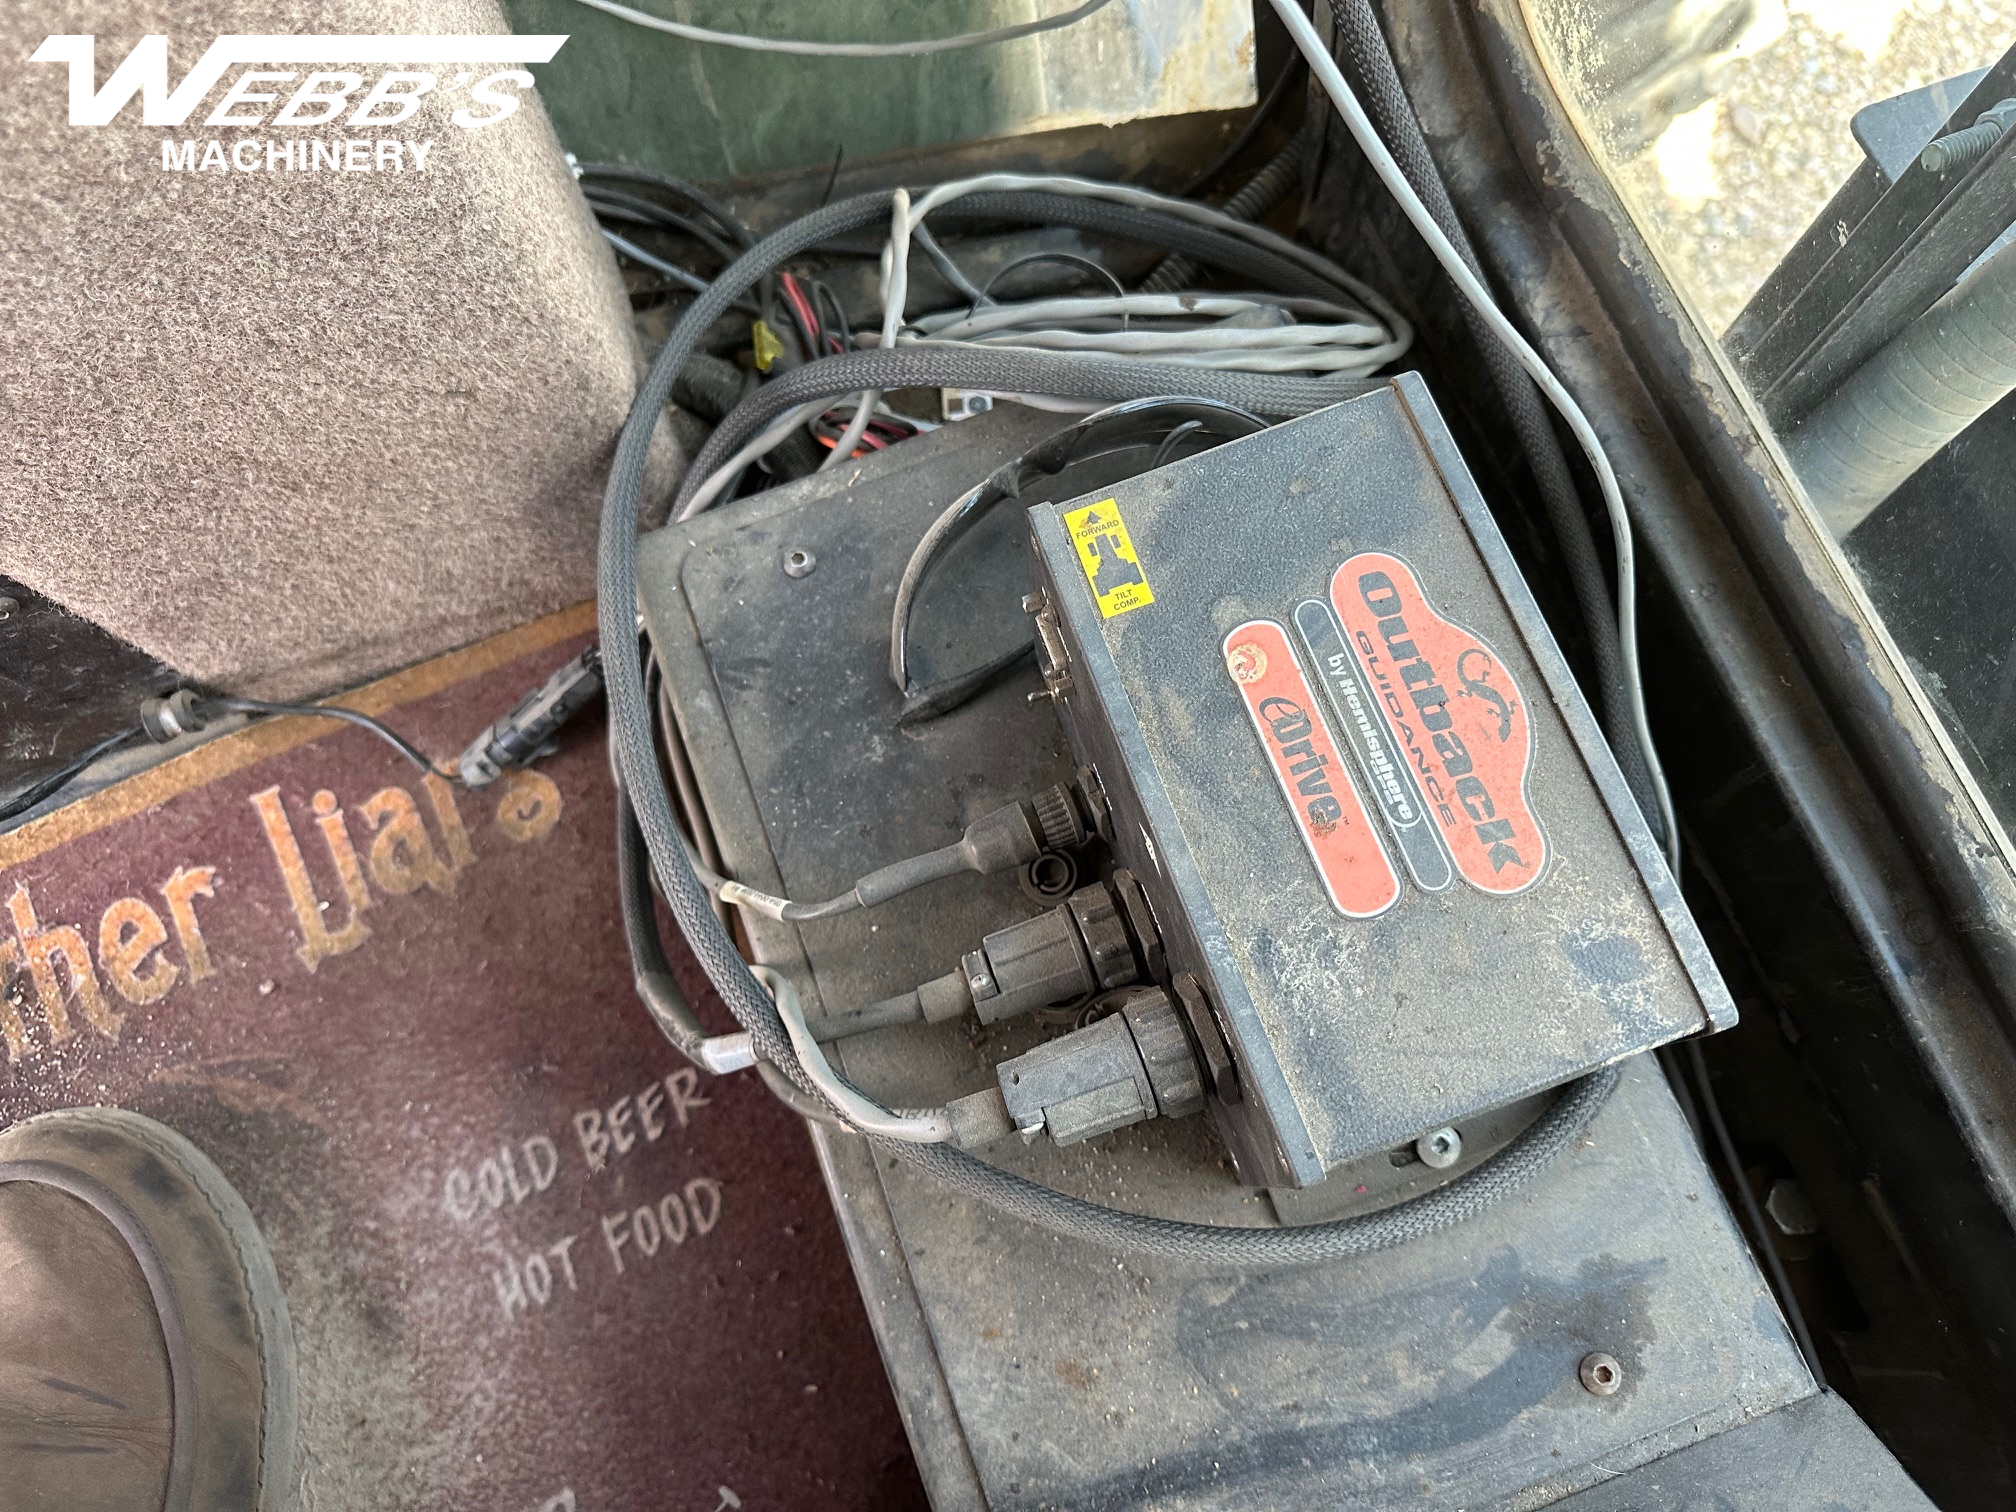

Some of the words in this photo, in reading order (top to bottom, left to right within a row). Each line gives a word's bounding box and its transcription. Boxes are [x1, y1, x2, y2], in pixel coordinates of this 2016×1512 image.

[1076, 519, 1120, 540] FORWARD
[1114, 589, 1133, 601] TILT
[1113, 597, 1142, 611] COMP.
[1327, 652, 1348, 678] by
[1338, 677, 1415, 822] Hemisphere
[1355, 630, 1457, 828] GUIDANCE
[1358, 570, 1523, 875] Outback
[444, 1135, 558, 1220] COLD
[573, 1067, 711, 1172] BEER
[493, 1234, 578, 1321] HOT
[602, 1177, 723, 1274] FOOD
